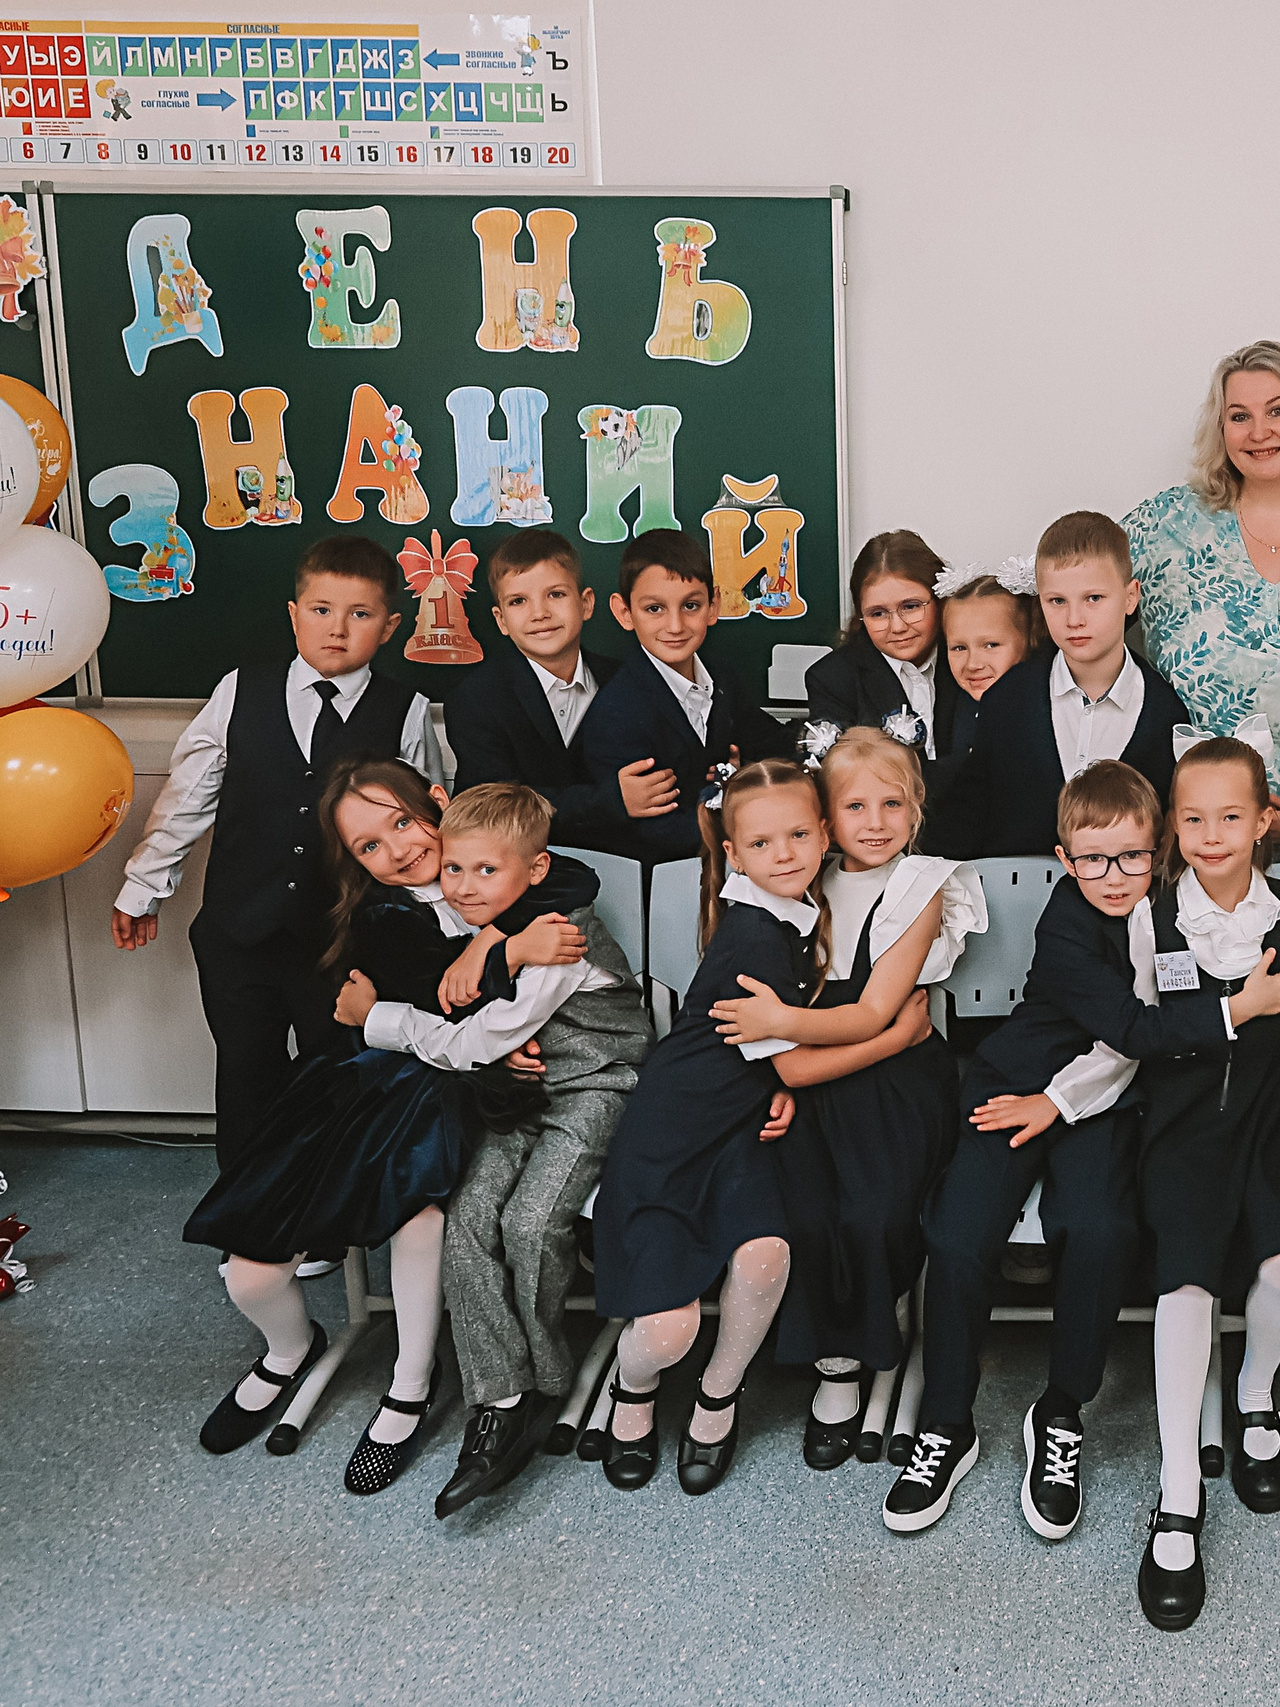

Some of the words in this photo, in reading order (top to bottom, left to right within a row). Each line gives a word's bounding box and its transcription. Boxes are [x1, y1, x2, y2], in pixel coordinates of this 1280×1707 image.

[227, 24, 280, 34] СОГЛАСНЫЕ
[2, 45, 20, 65] У
[29, 45, 56, 66] Ы
[63, 45, 82, 66] Э
[92, 41, 112, 66] Й
[125, 47, 143, 67] Л
[153, 47, 175, 67] М
[185, 47, 203, 67] Н
[215, 48, 233, 68] Р
[246, 48, 265, 68] Б
[276, 48, 295, 68] В
[308, 48, 322, 69] Г
[336, 48, 356, 73] Д
[362, 49, 389, 70] Ж
[398, 49, 414, 70] З
[546, 51, 569, 70] Ъ
[3, 87, 30, 108] Ю
[37, 87, 56, 108] И
[68, 87, 85, 108] Е
[249, 90, 268, 110] П
[276, 90, 299, 110] Ф
[310, 90, 326, 111] К
[339, 90, 355, 111] Т
[365, 91, 391, 111] Ш
[399, 91, 417, 112] С
[429, 91, 448, 112] Х
[458, 91, 478, 116] Ц
[490, 91, 508, 112] Ч
[516, 92, 543, 116] Щ
[551, 93, 568, 112] Ь
[22, 142, 34, 159] 6
[60, 142, 72, 159] 7
[97, 143, 110, 160] 8
[137, 143, 148, 160] 9
[170, 144, 192, 161] 10
[206, 144, 226, 161] 11
[245, 144, 267, 161] 12
[281, 145, 304, 161] 13
[320, 145, 342, 161] 14
[357, 145, 379, 162] 15
[396, 146, 418, 162] 16
[434, 146, 455, 163] 17
[471, 146, 493, 163] 18
[510, 147, 531, 163] 19
[547, 147, 569, 164] 20
[122, 206, 752, 376] ДЕНЬ
[89, 384, 807, 619] ЗНАНИЙ
[428, 590, 455, 628] 1
